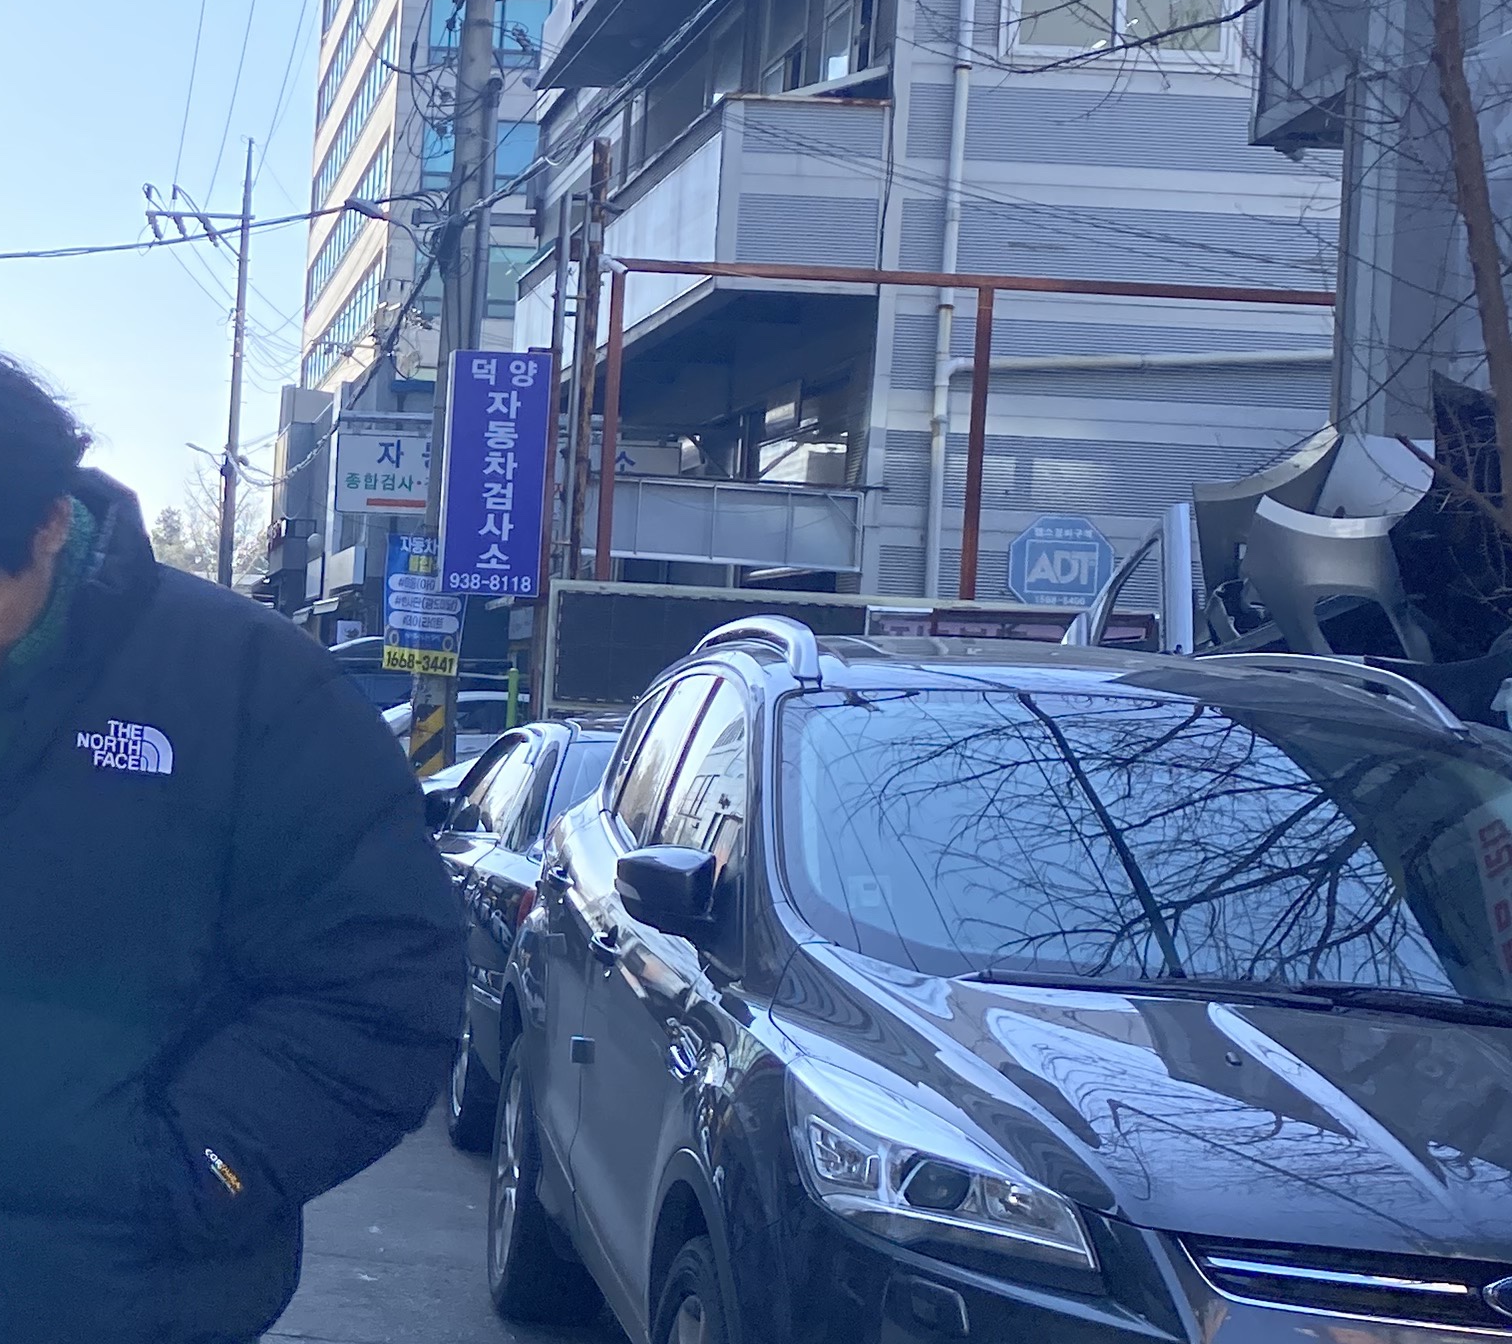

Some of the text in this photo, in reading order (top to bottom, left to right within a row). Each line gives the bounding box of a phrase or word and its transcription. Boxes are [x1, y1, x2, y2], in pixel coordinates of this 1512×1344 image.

[476, 390, 522, 571] 자동차검사소
[1027, 549, 1096, 585] ADT
[449, 572, 531, 591] 938-8118
[386, 650, 454, 673] 1668-3441
[108, 720, 143, 740] THE
[77, 732, 141, 757] NORTH
[93, 750, 140, 771] FACE
